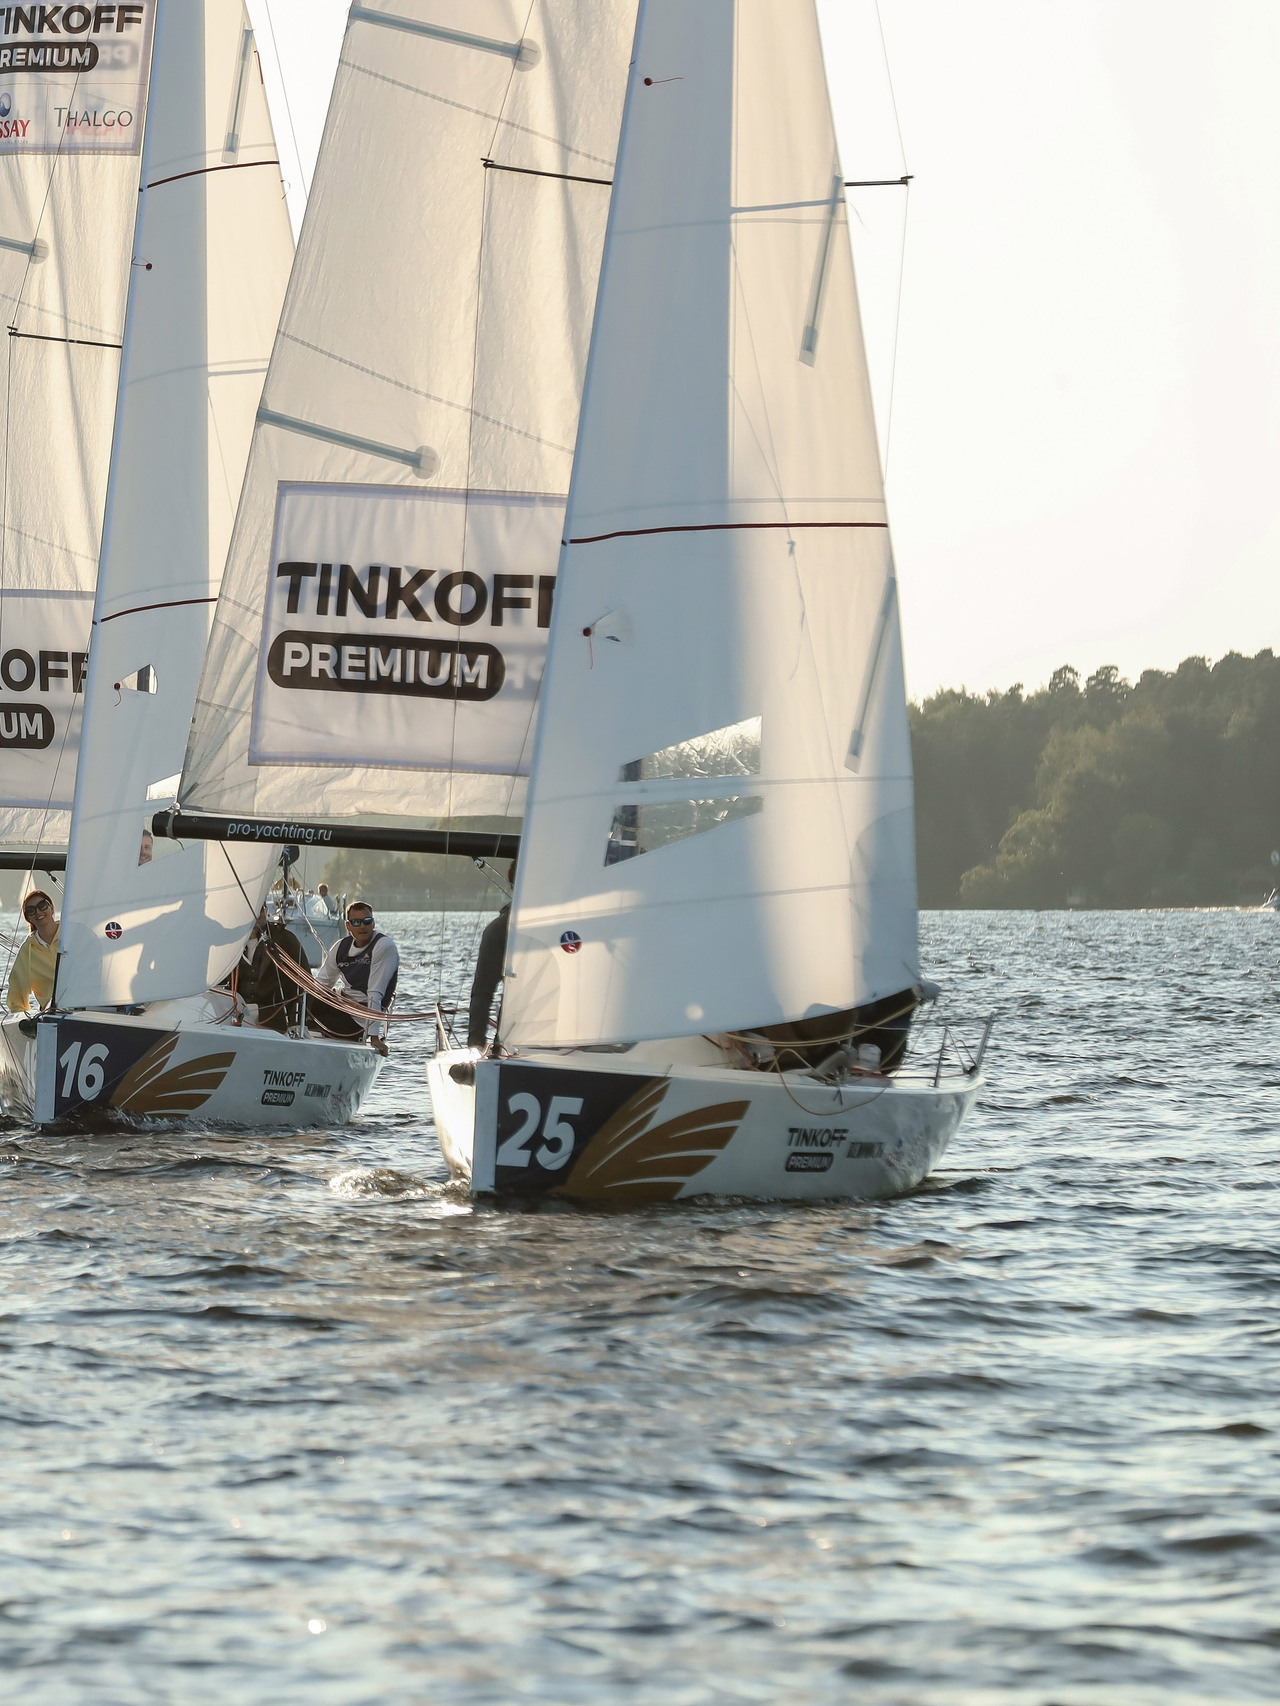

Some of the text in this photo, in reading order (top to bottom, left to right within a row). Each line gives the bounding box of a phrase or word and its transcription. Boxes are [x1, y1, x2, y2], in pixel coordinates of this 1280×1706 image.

[53, 107, 133, 128] THALGO
[281, 641, 490, 690] PREMIUM
[226, 820, 333, 843] pro-yachting.ru
[59, 1041, 110, 1102] 16
[263, 1069, 306, 1087] TINKOFF
[263, 1092, 294, 1104] PREMIUM
[496, 1092, 585, 1171] 25
[787, 1127, 849, 1148] TINKOFF
[787, 1155, 833, 1169] PREMIUM
